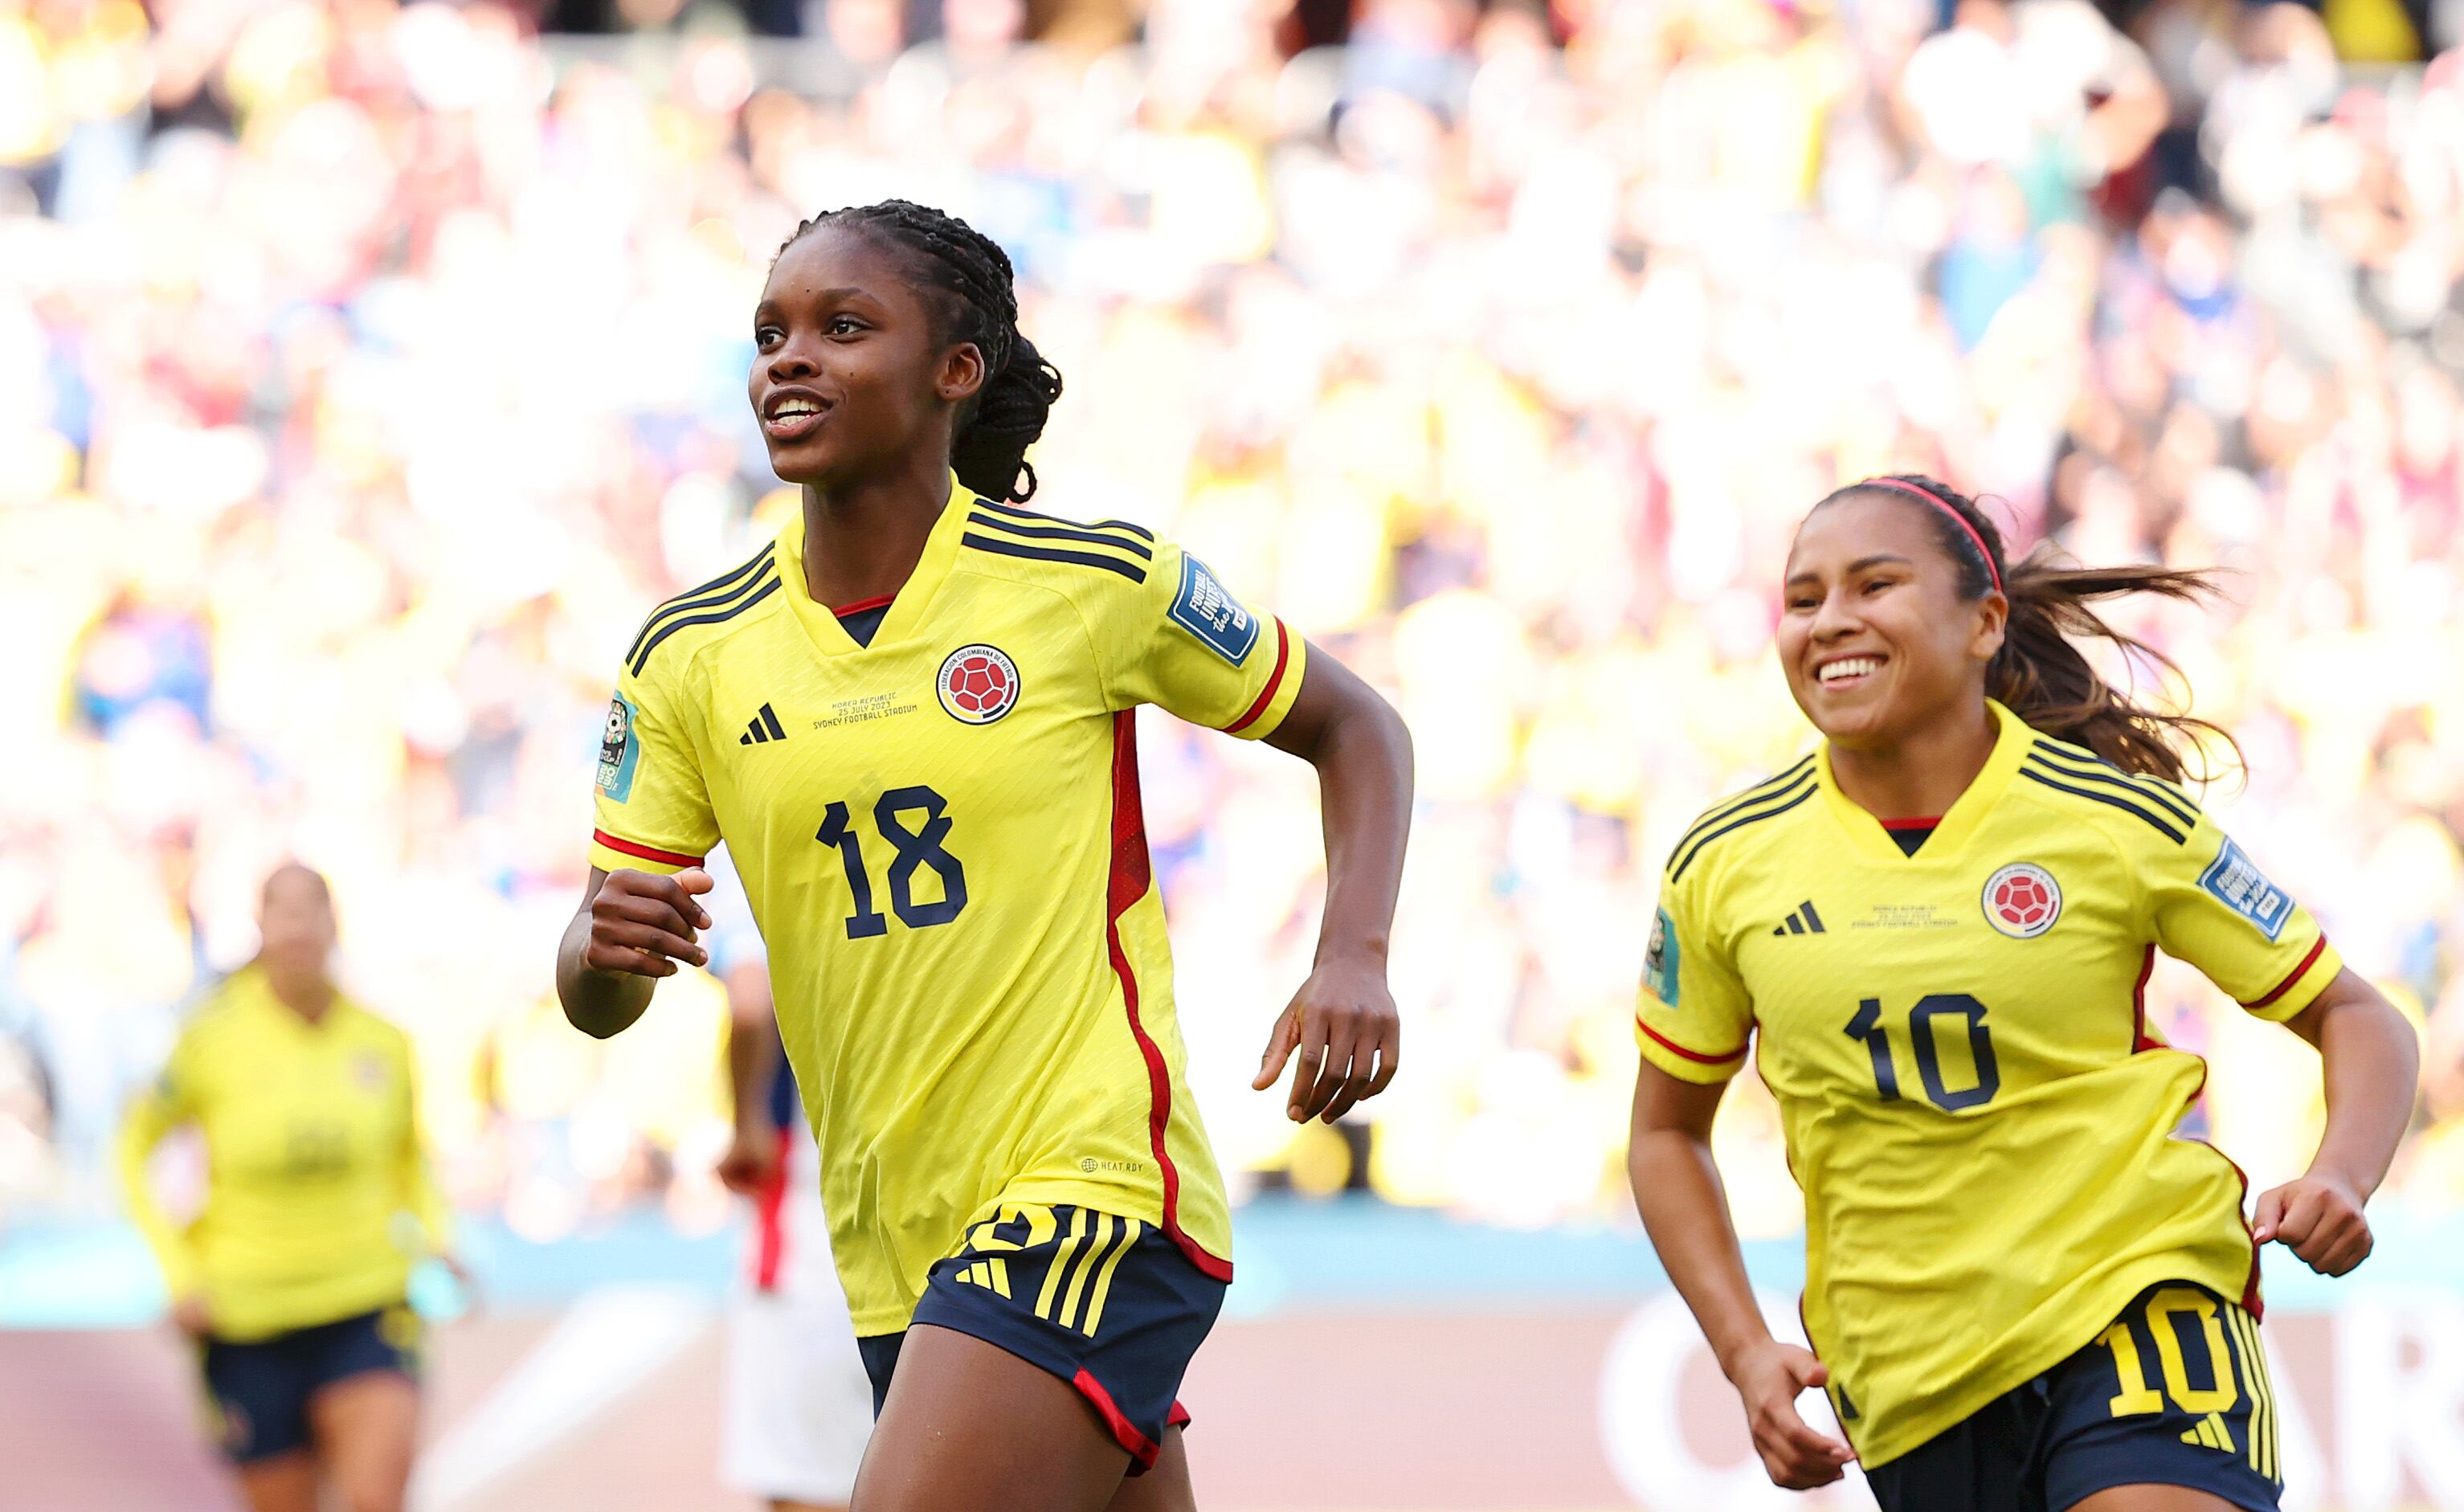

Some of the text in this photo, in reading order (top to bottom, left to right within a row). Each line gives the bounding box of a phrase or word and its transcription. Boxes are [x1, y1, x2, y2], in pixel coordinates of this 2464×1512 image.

[1188, 569, 1206, 612] FOOTBALL
[1212, 612, 1231, 633] the
[957, 648, 994, 660] COLOMBIANA
[838, 701, 891, 717] 25 JULY 2023
[860, 691, 897, 705] REPUBLIC
[812, 704, 918, 730] SYDNEY FOOTBALL STADIUM
[815, 784, 968, 940] 18
[1843, 993, 2000, 1112] 10
[2094, 1287, 2239, 1419] 10
